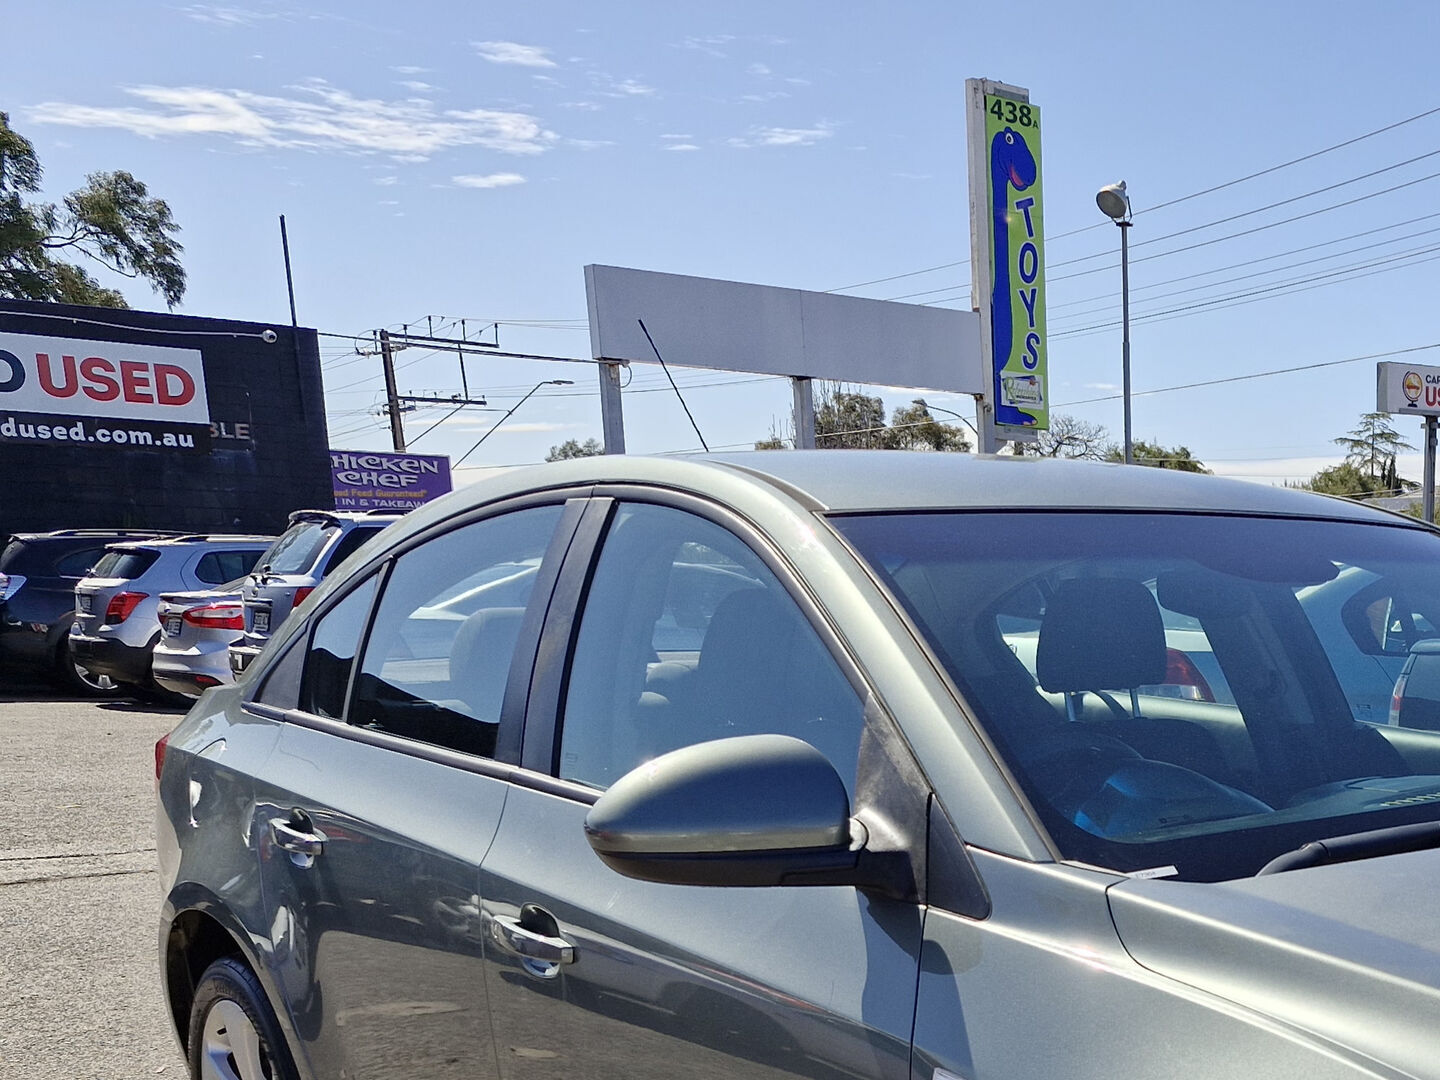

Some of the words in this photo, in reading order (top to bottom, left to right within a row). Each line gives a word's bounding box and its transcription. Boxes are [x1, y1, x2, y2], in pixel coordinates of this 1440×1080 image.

[1015, 197, 1041, 370] TOYS
[35, 353, 196, 407] USED
[1, 417, 194, 447] dused.com.au
[342, 498, 356, 506] IN
